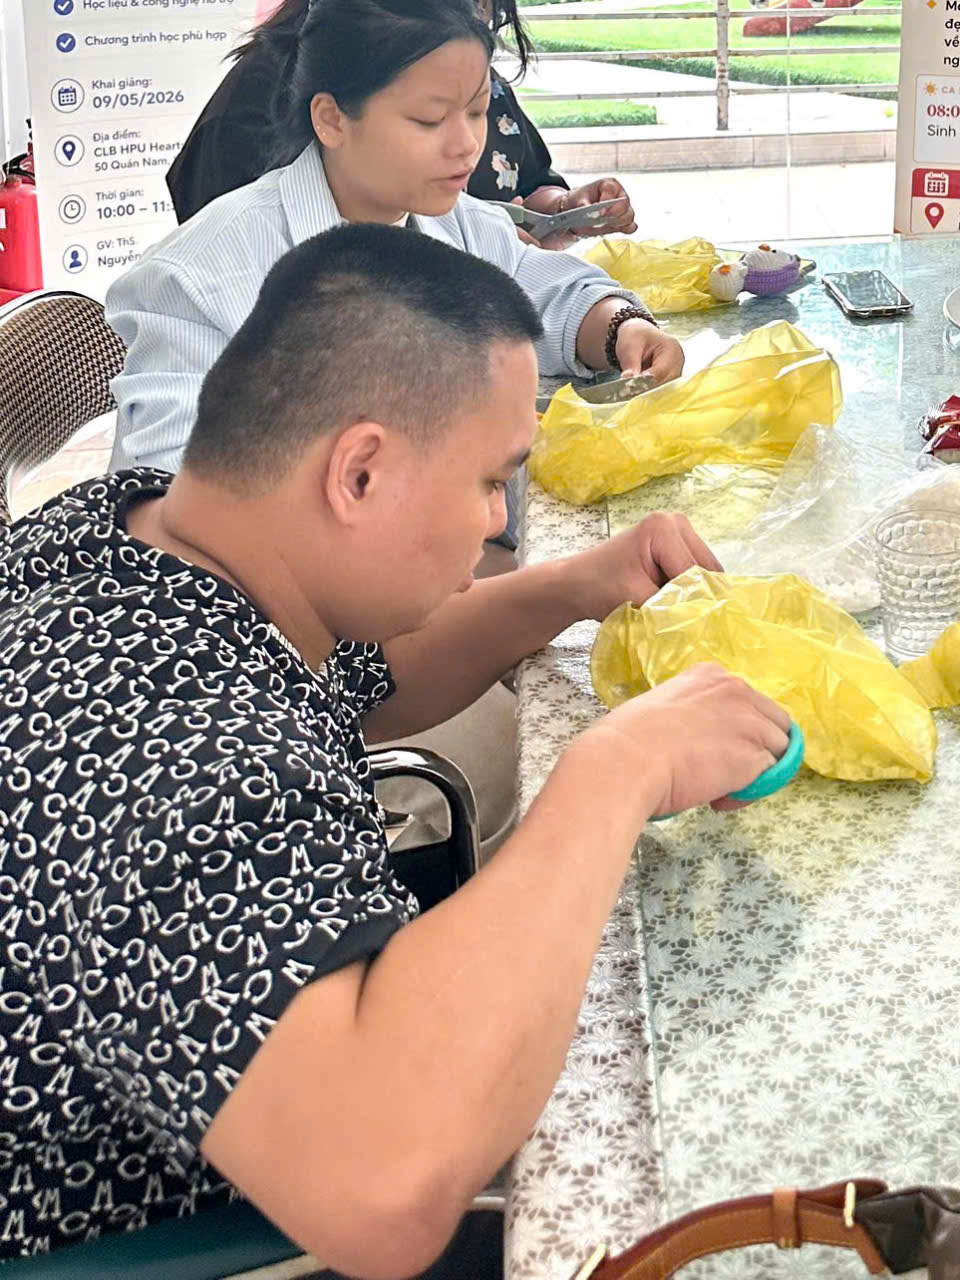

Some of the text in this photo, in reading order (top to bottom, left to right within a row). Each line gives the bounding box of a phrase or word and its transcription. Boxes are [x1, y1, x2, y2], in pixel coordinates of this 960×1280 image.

[83, 0, 105, 11] Học
[85, 30, 227, 46] Chương trình học phù hợp
[944, 35, 960, 48] về
[92, 77, 152, 91] Khai giảng:
[941, 85, 956, 95] CA
[92, 90, 184, 109] 09/05/2026
[93, 128, 142, 143] Địa điểm:
[927, 124, 957, 138] Sinh
[93, 142, 184, 158] CLB HPU Heart
[95, 161, 109, 172] 50
[111, 158, 140, 170] Quán
[96, 188, 145, 201] Thời gian:
[97, 203, 136, 220] 10:00
[96, 239, 115, 251] GV:
